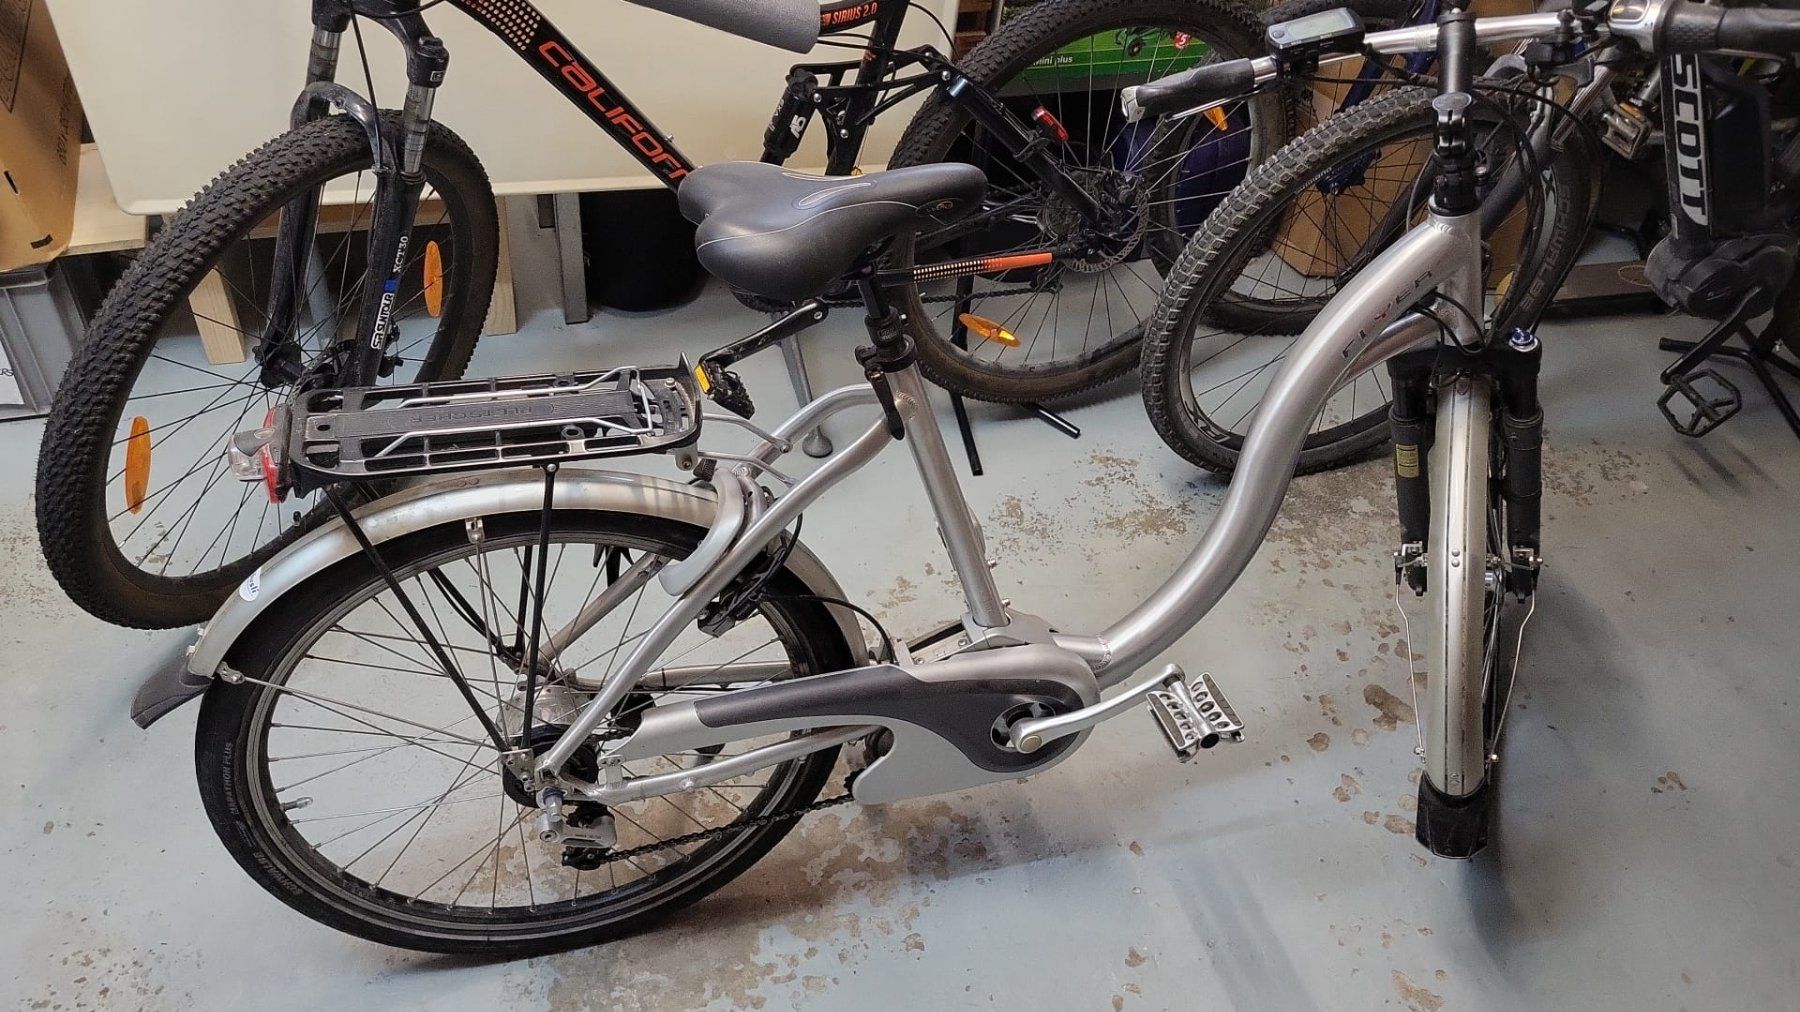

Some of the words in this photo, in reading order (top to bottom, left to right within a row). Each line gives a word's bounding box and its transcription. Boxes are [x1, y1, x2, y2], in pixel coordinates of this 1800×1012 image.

[832, 6, 862, 25] SIRIUS
[863, 2, 878, 18] 2.0
[1673, 53, 1706, 217] SCOTT
[376, 293, 395, 333] SUNTOUR
[371, 331, 386, 350] SR
